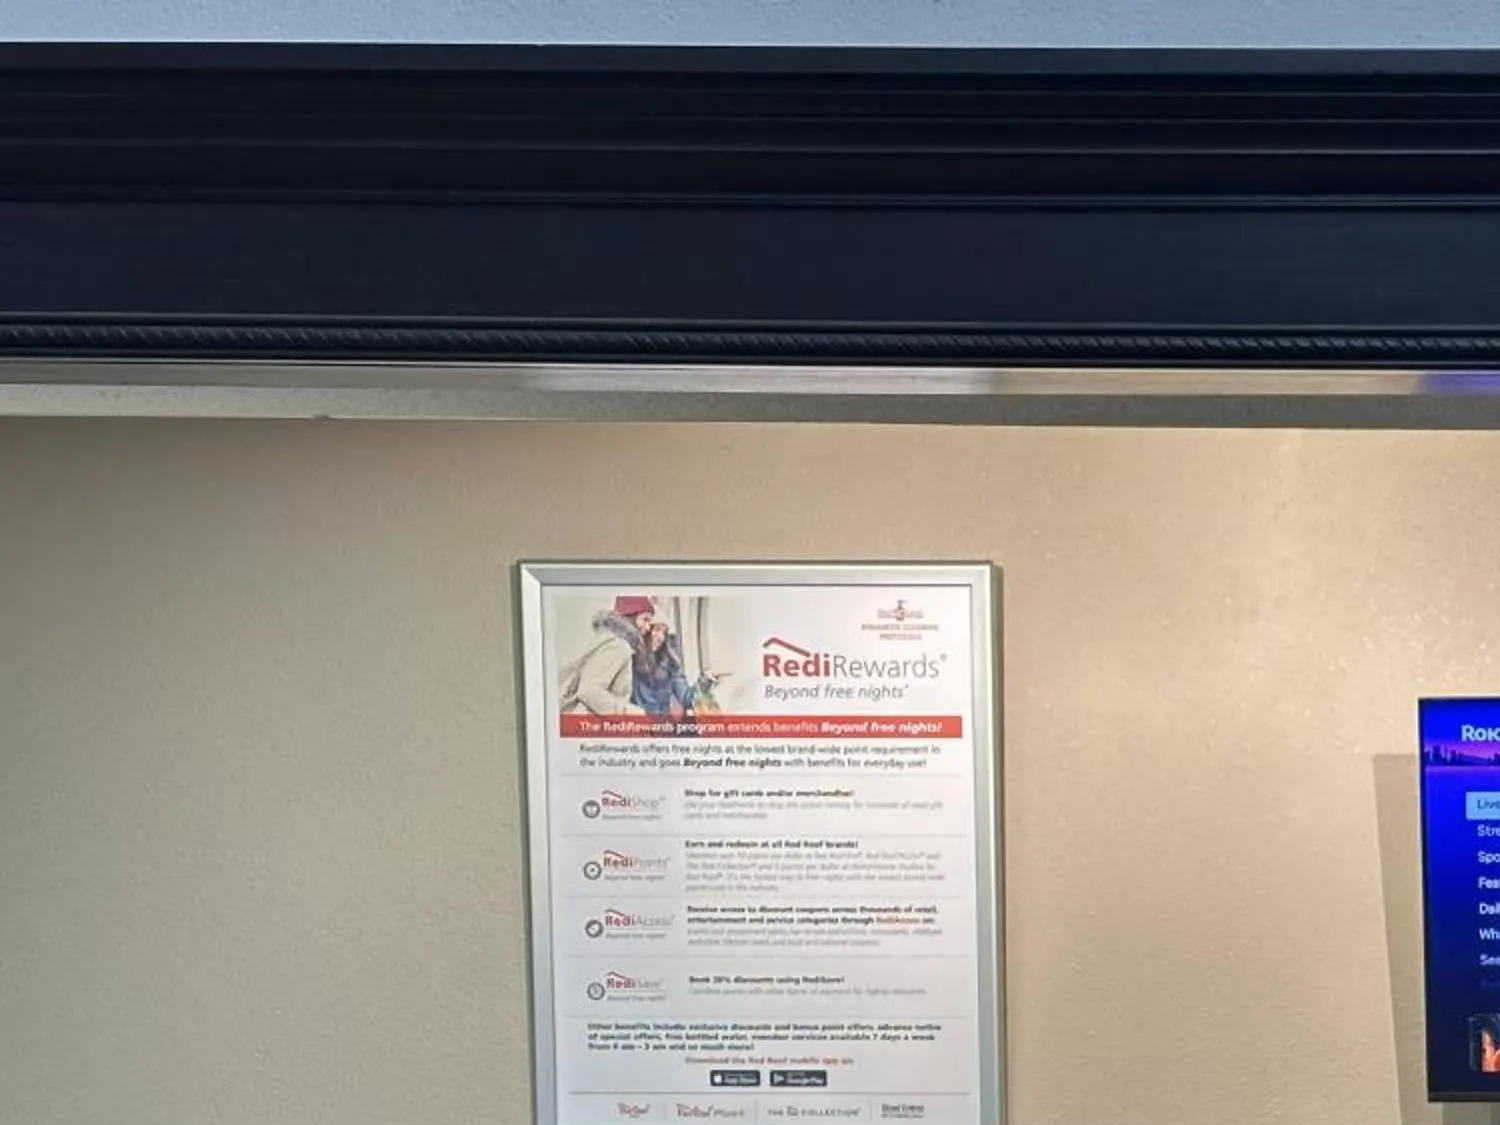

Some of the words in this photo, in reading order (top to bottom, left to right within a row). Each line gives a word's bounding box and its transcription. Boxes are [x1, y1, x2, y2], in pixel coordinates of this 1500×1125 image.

[764, 684, 819, 701] Beyond
[824, 684, 857, 699] free
[580, 722, 600, 733] The
[677, 722, 725, 736] program
[727, 722, 770, 733] extends
[774, 722, 819, 733] benefits
[820, 722, 868, 736] Beyond
[870, 722, 897, 733] free
[683, 757, 722, 771] Beyond
[725, 758, 746, 768] free
[748, 758, 781, 771] nights
